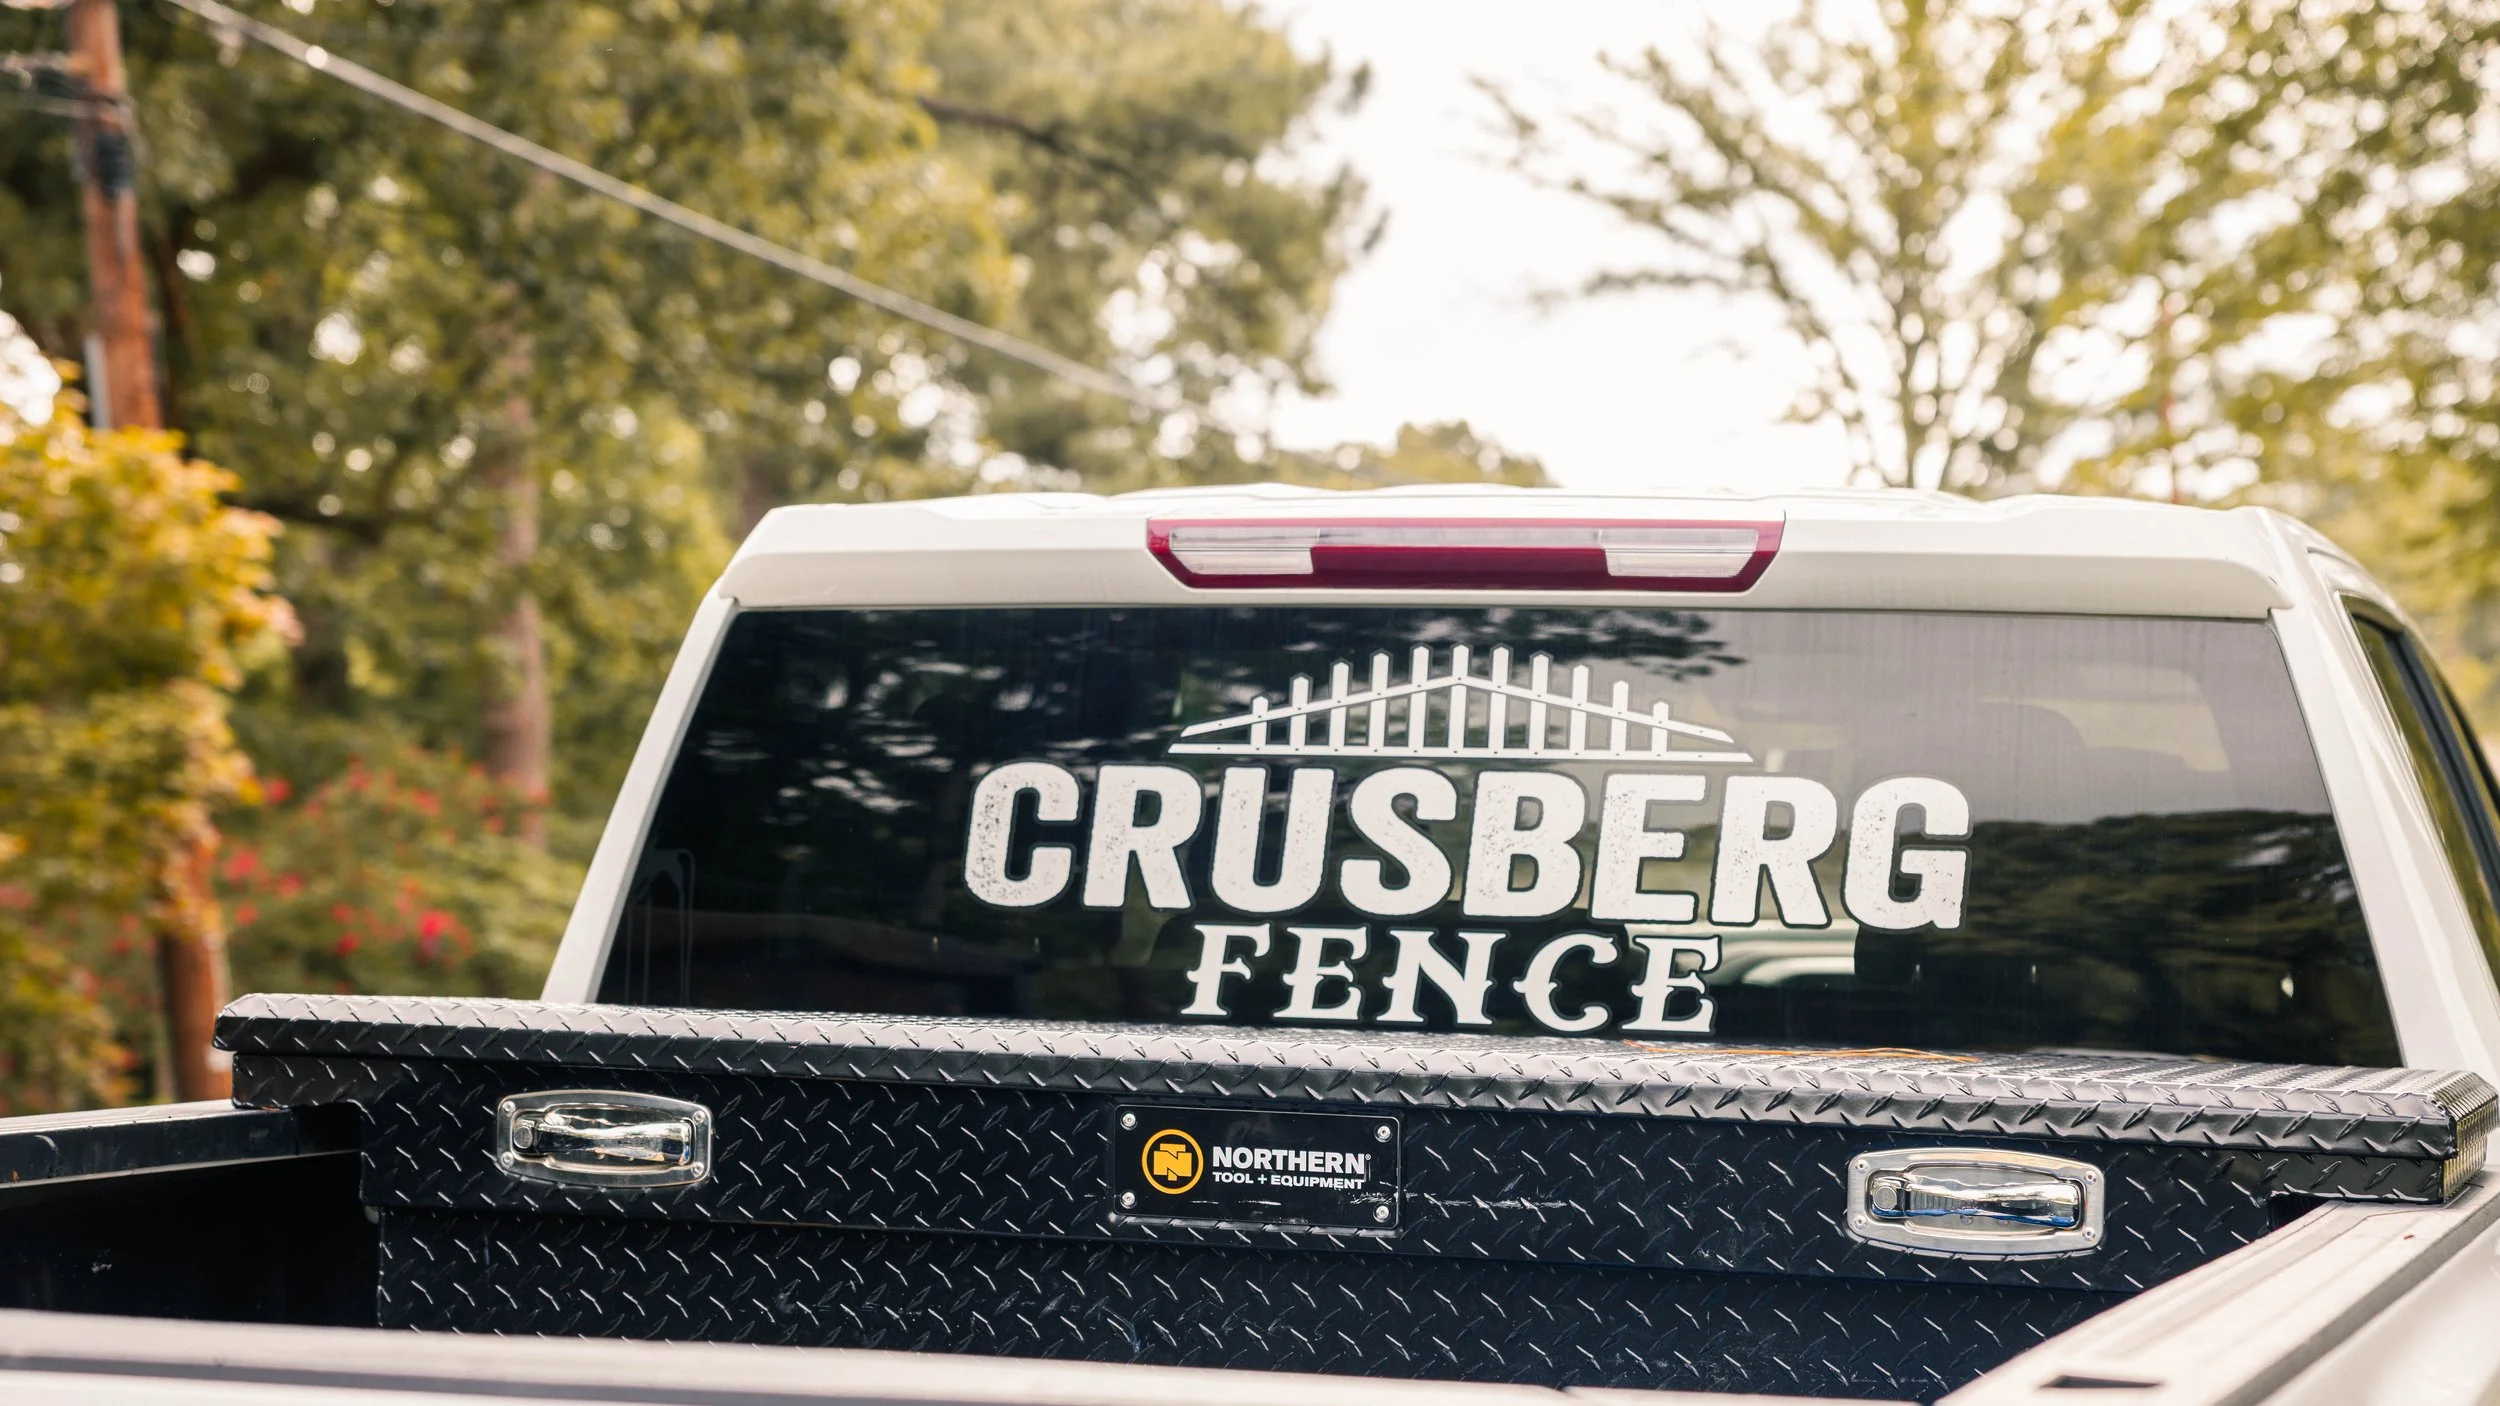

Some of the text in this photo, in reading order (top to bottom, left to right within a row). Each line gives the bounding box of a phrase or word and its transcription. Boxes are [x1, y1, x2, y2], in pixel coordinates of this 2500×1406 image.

[964, 761, 1971, 930] CRUSBERG
[1181, 924, 1721, 1034] FENCE
[1212, 1172, 1254, 1184] TOOL
[1270, 1174, 1364, 1190] EQUIPMENT
